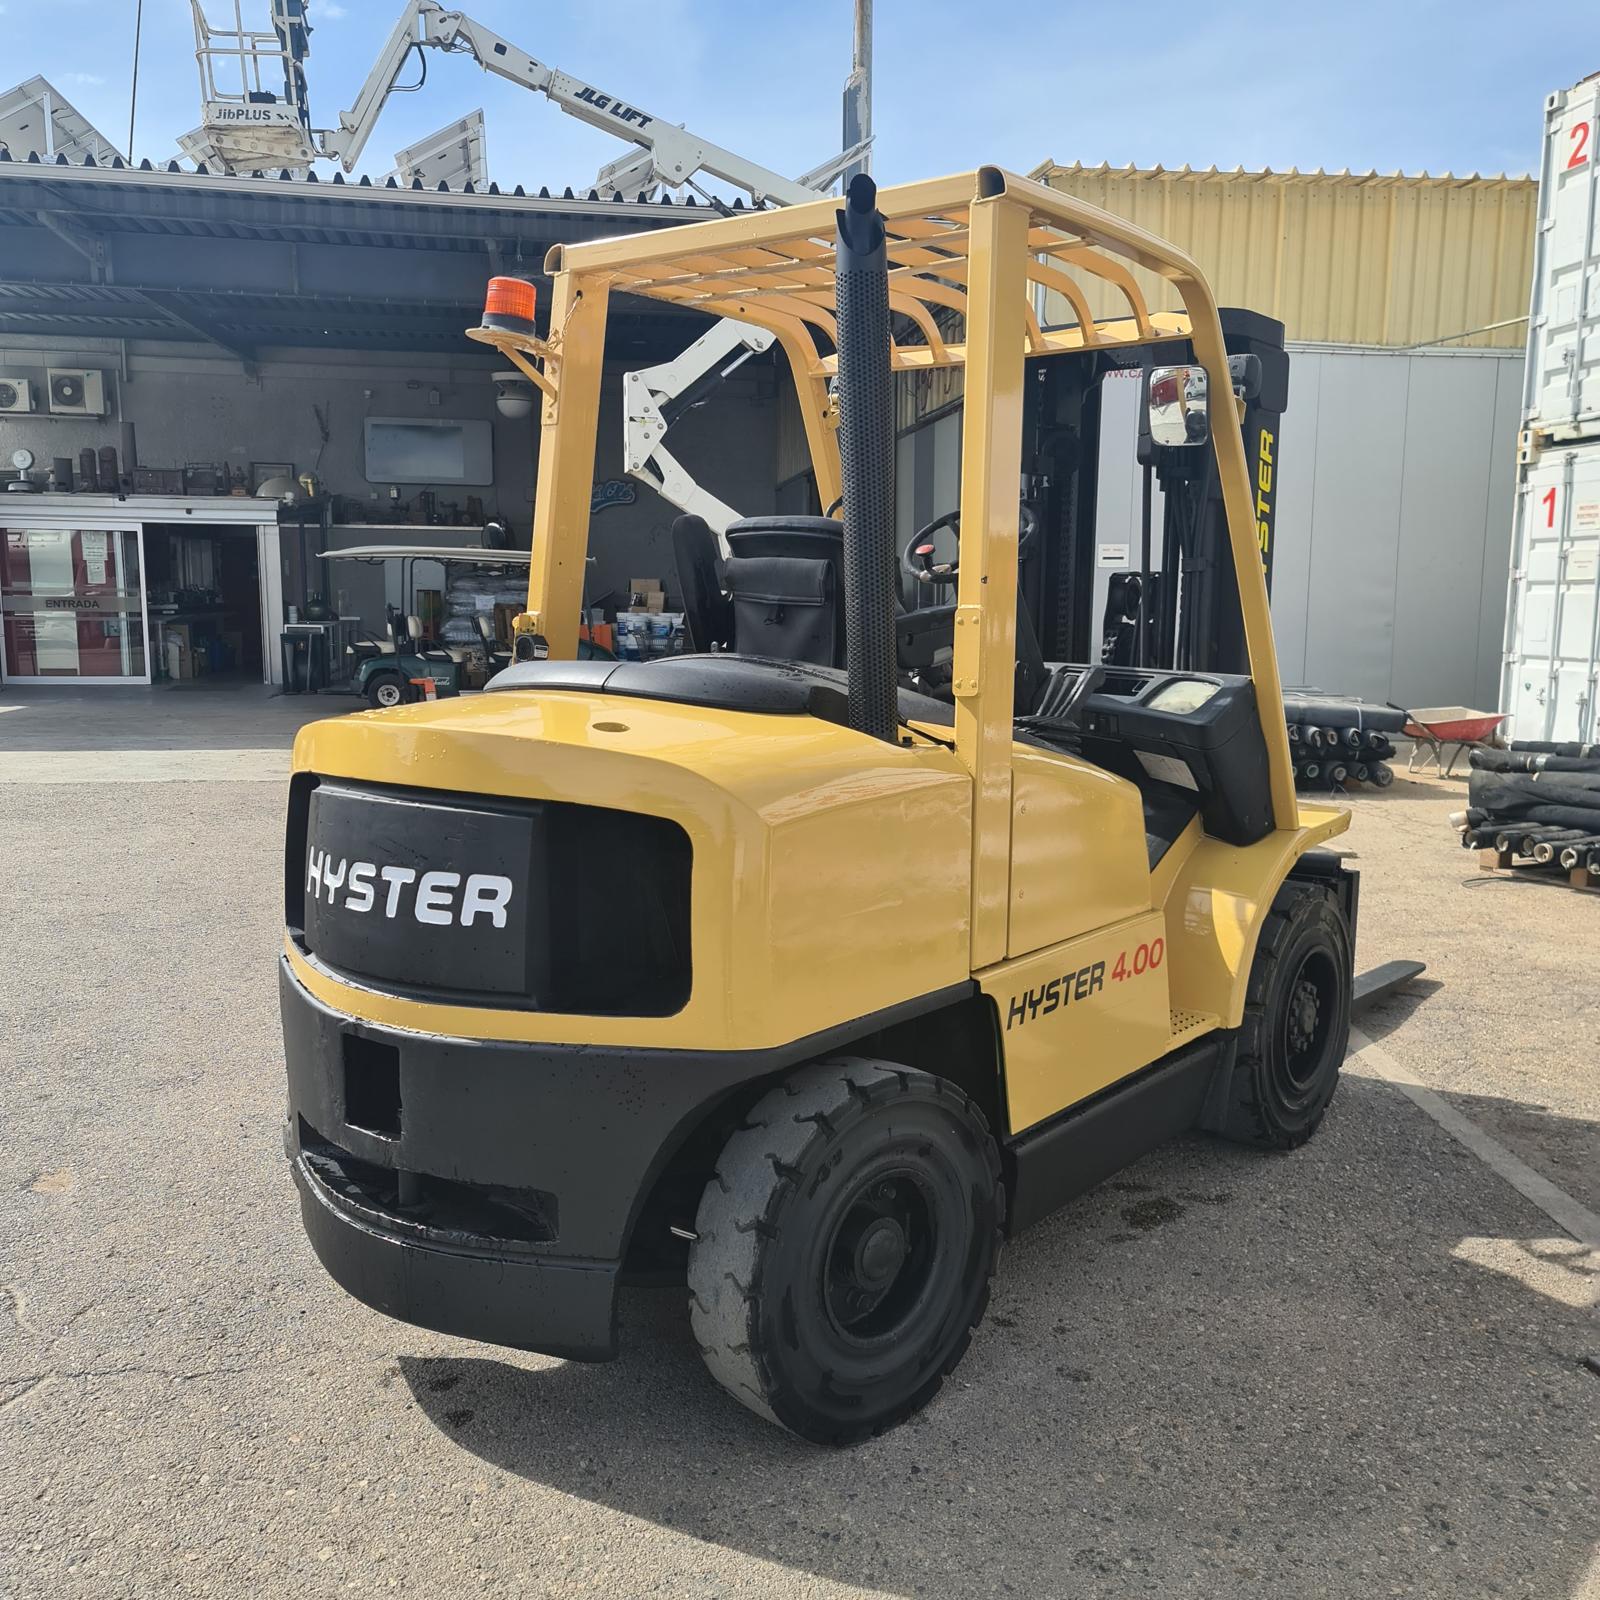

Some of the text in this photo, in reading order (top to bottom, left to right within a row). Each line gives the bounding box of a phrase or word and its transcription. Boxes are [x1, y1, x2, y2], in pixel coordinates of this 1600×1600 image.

[215, 108, 271, 120] JibPLUS
[573, 86, 653, 128] JLG LIFT
[1567, 121, 1589, 169] 2
[1256, 428, 1274, 575] STER
[1542, 487, 1556, 528] 1
[46, 599, 100, 609] ENTRADA
[307, 845, 513, 928] HYSTER
[1006, 937, 1164, 1031] HYSTER 4.00
